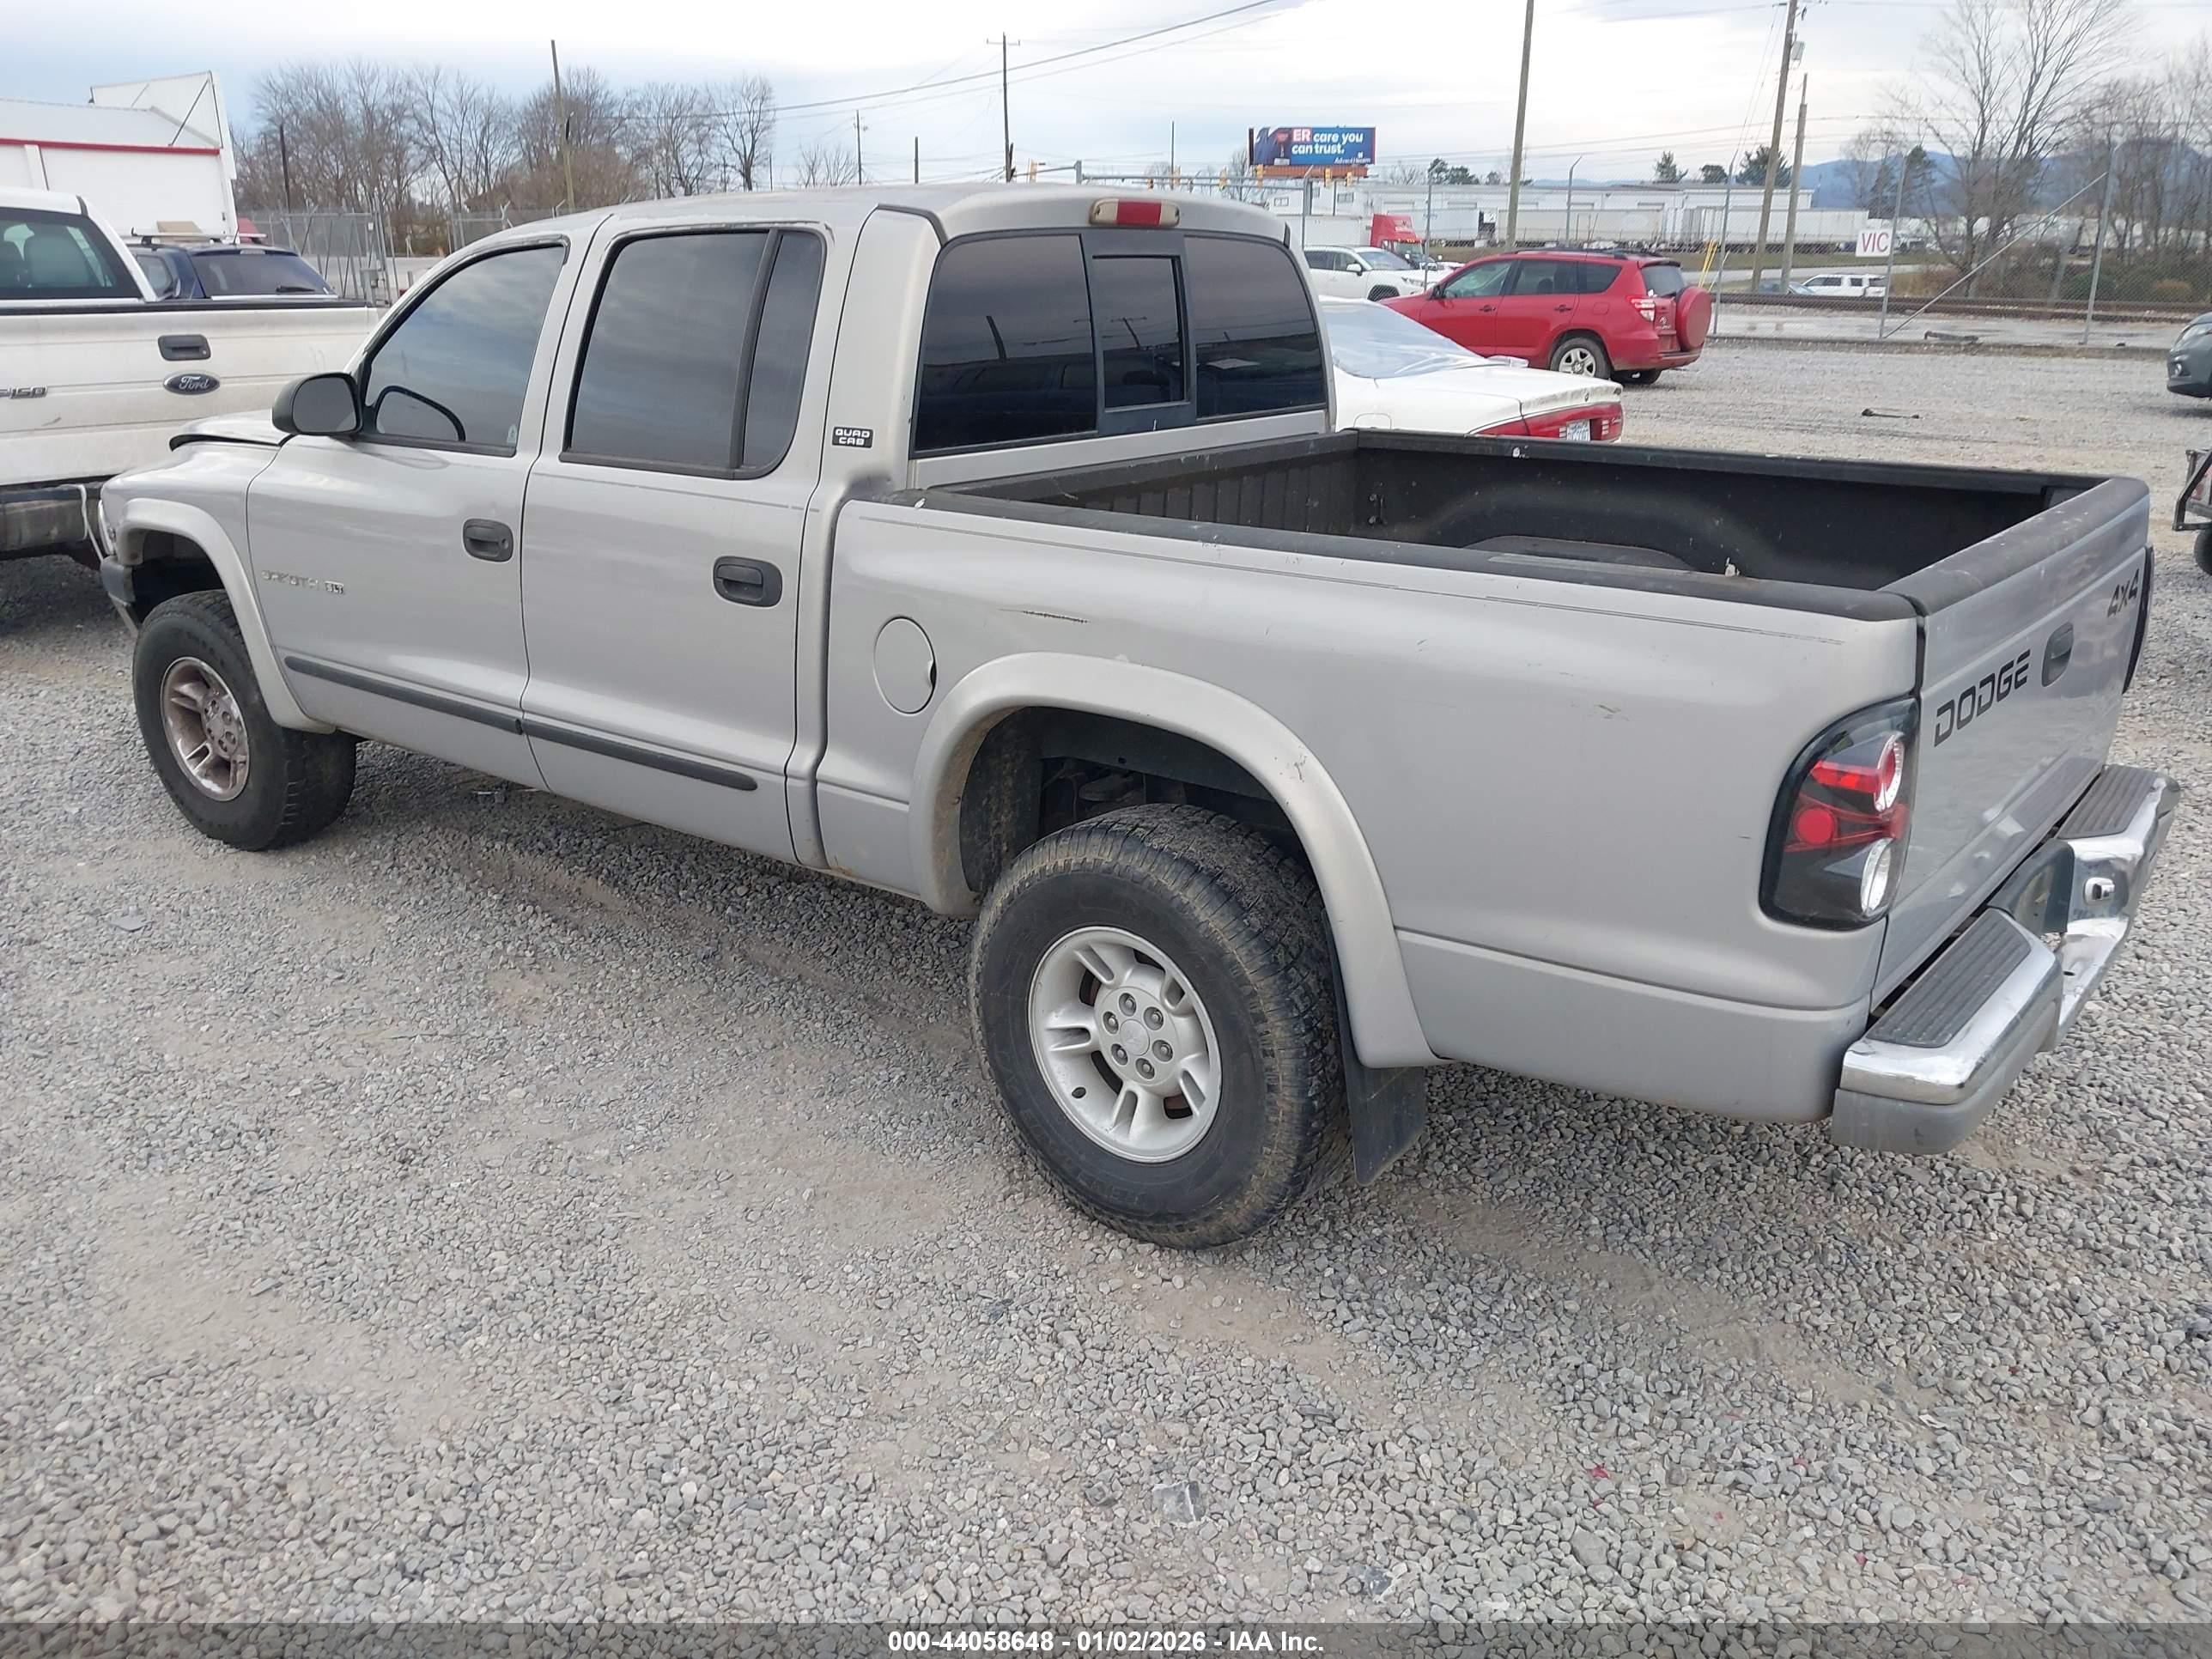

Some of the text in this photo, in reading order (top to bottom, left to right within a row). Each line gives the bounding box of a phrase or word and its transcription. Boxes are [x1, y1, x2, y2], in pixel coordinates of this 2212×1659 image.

[1292, 128, 1364, 144] ER care you
[1291, 143, 1345, 155] can trust.
[1862, 232, 1889, 252] VIC
[178, 375, 210, 389] Ford
[835, 428, 871, 438] QUAD
[838, 436, 865, 447] CAB
[1933, 648, 2031, 747] DODGE
